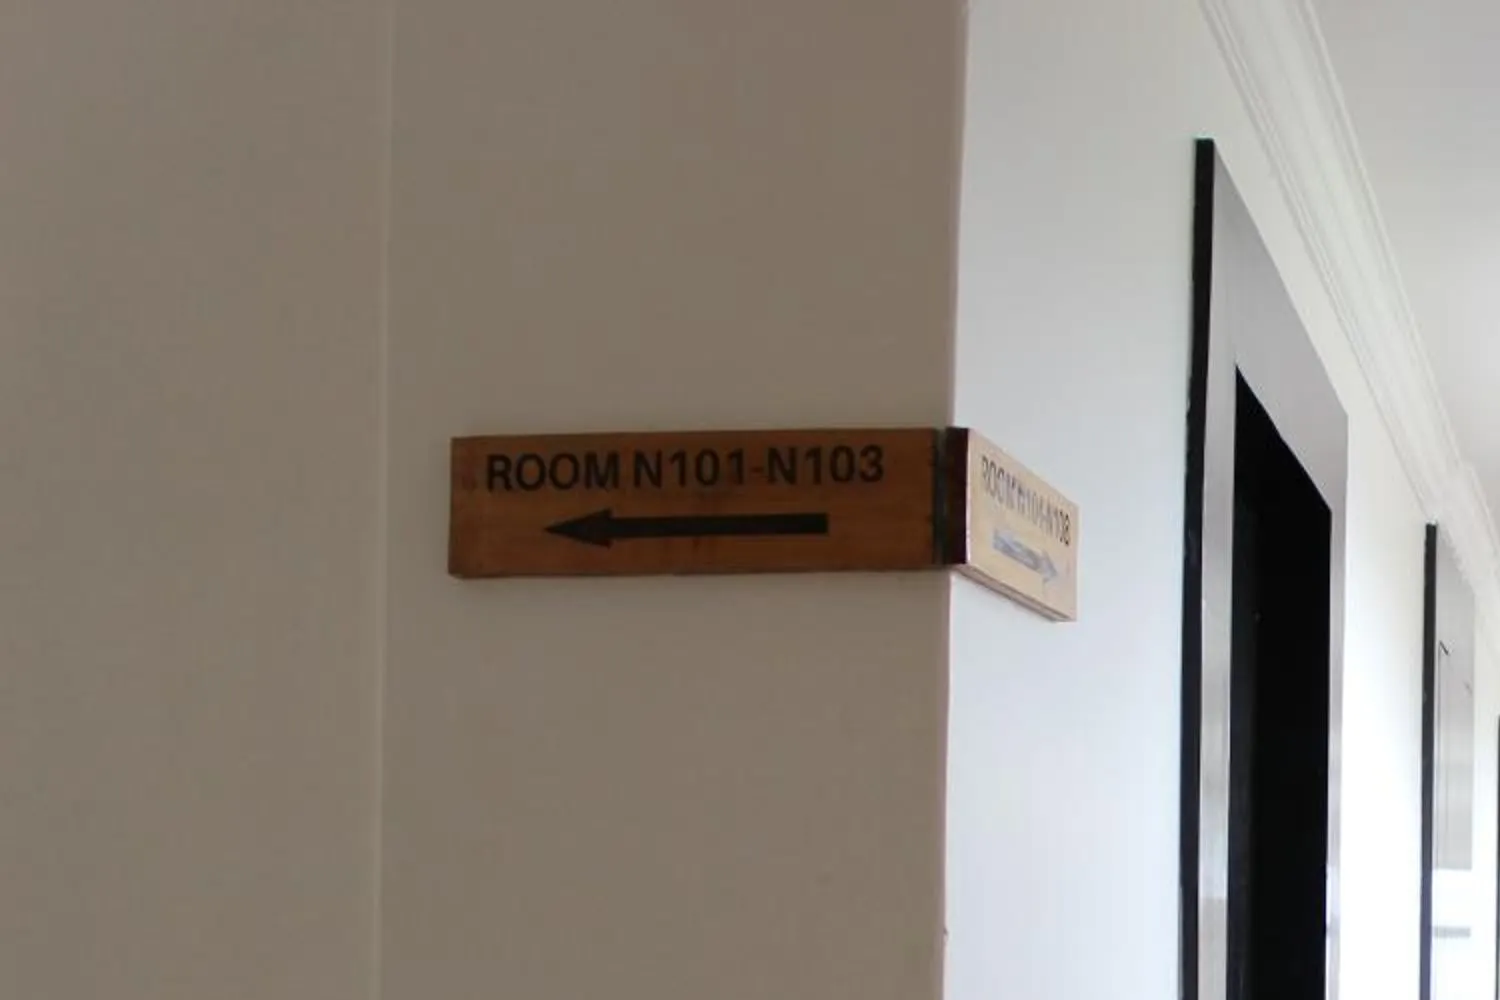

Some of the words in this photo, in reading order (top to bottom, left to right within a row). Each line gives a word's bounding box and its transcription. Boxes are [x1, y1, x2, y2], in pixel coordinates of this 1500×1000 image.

[486, 451, 620, 492] ROOM
[632, 445, 885, 488] N101-N103
[982, 455, 1016, 511] ROOM
